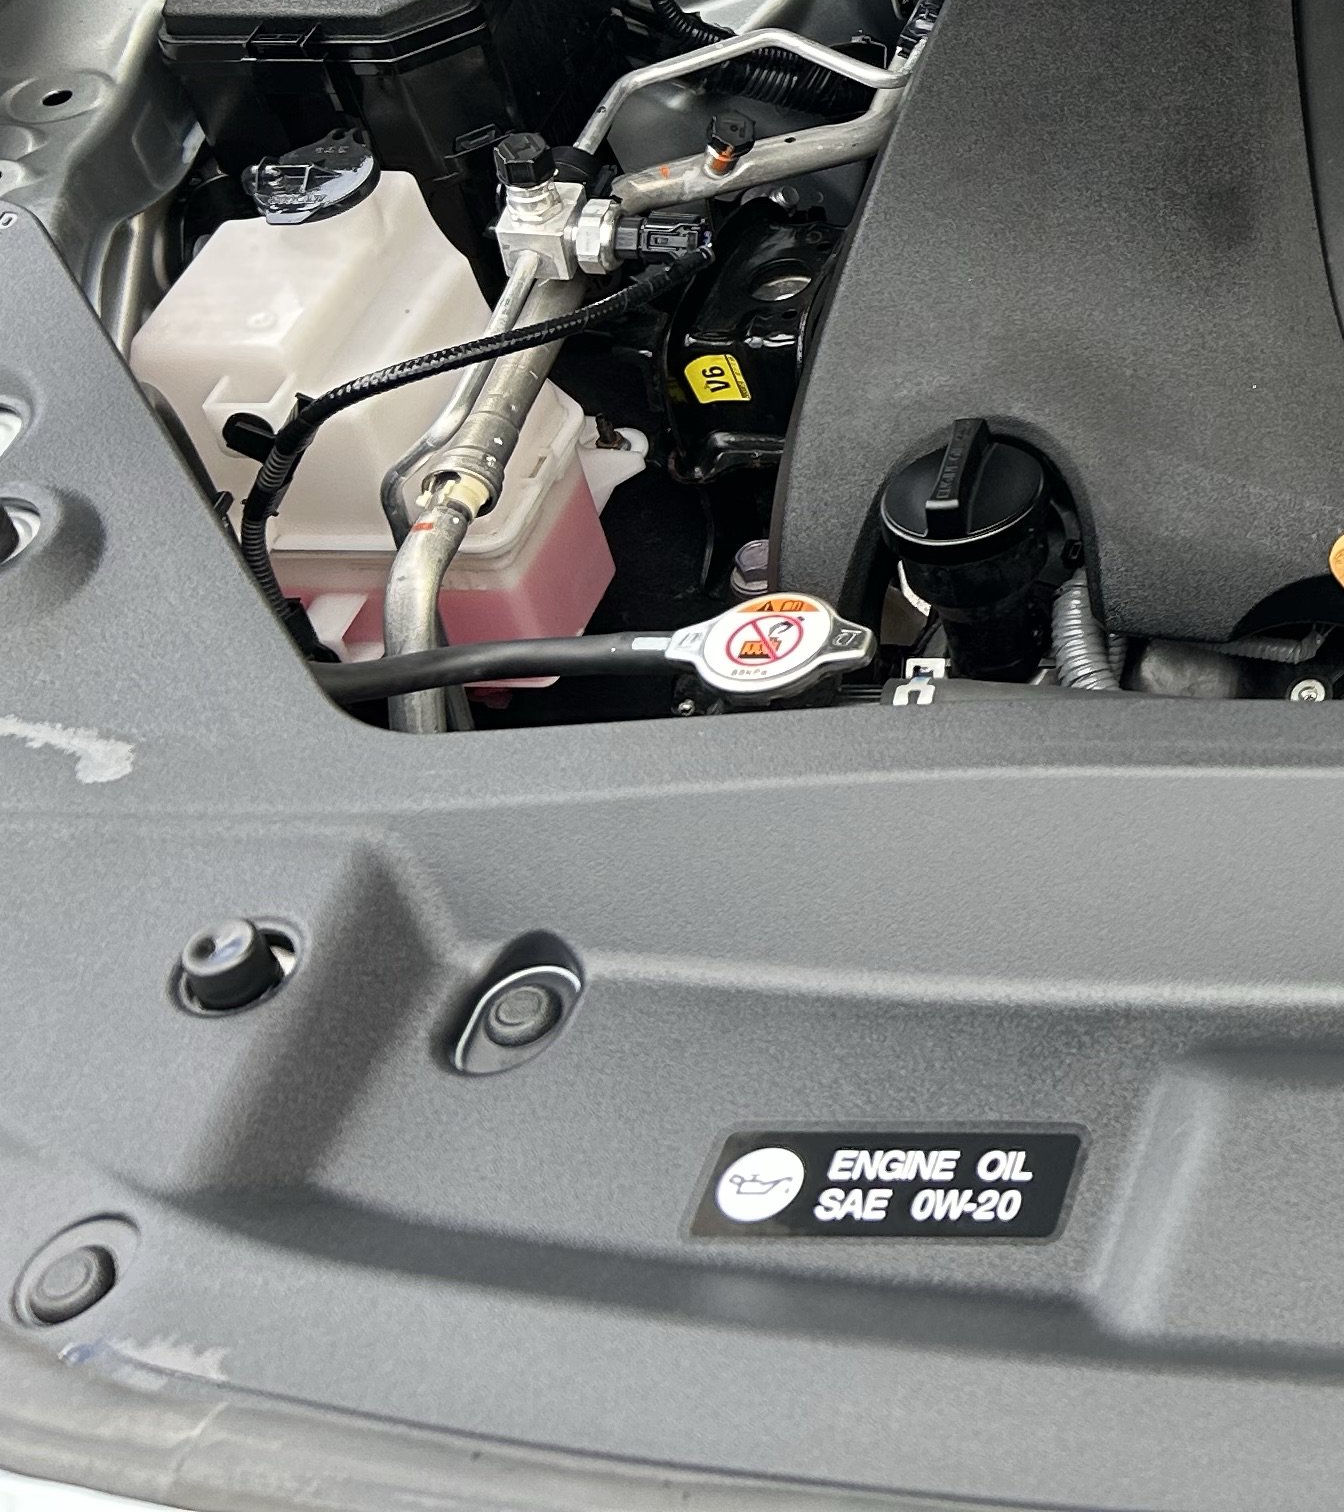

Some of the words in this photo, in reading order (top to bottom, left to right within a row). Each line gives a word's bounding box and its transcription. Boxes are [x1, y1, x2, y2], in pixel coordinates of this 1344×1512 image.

[702, 365, 731, 393] V6
[827, 1149, 961, 1182] ENGINE
[977, 1150, 1034, 1182] OIL
[813, 1189, 893, 1221] SAE
[909, 1189, 1022, 1222] 0W-20
